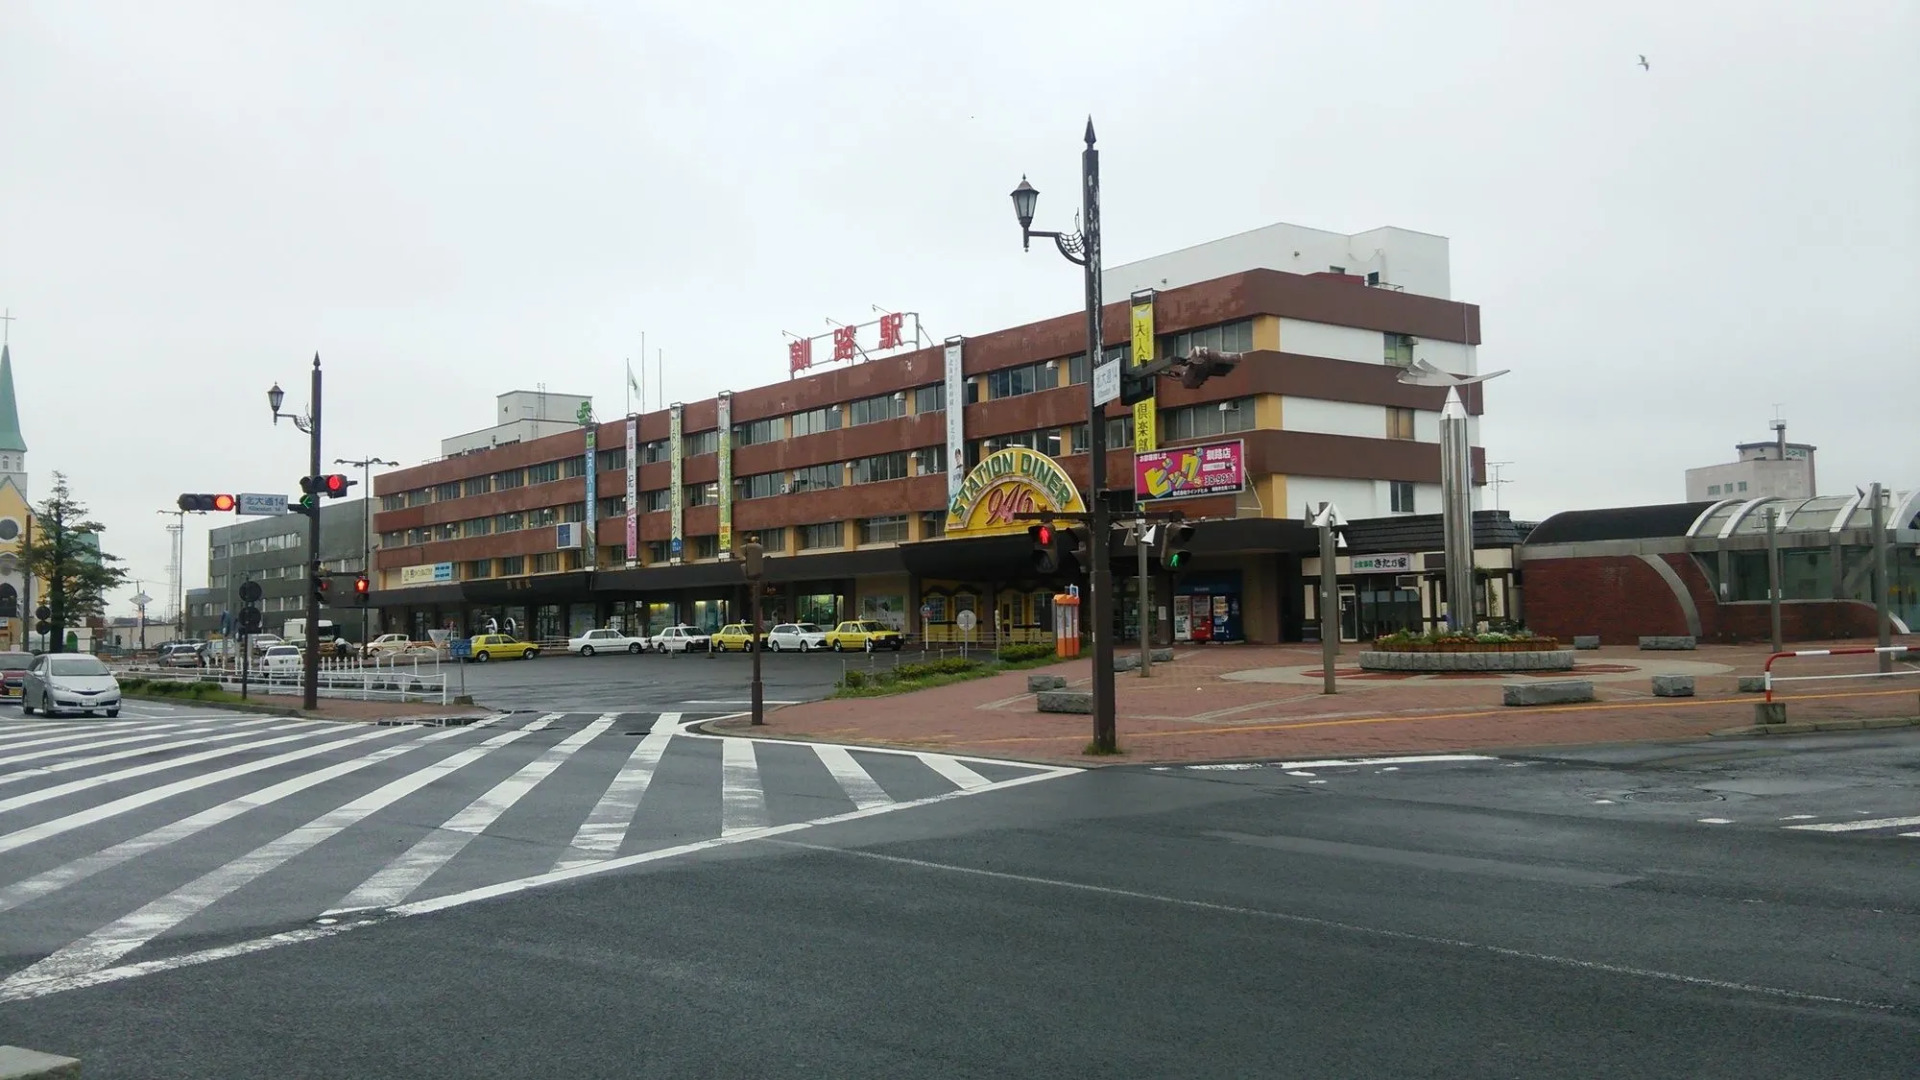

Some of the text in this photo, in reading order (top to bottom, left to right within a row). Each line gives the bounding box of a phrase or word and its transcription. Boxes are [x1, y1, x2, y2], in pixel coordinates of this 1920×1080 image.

[790, 312, 903, 372] 釧路駅
[1144, 447, 1203, 498] ビッグ
[1206, 447, 1231, 461] 釧路店
[951, 452, 1072, 519] STATION DINER
[986, 484, 1034, 525] 946
